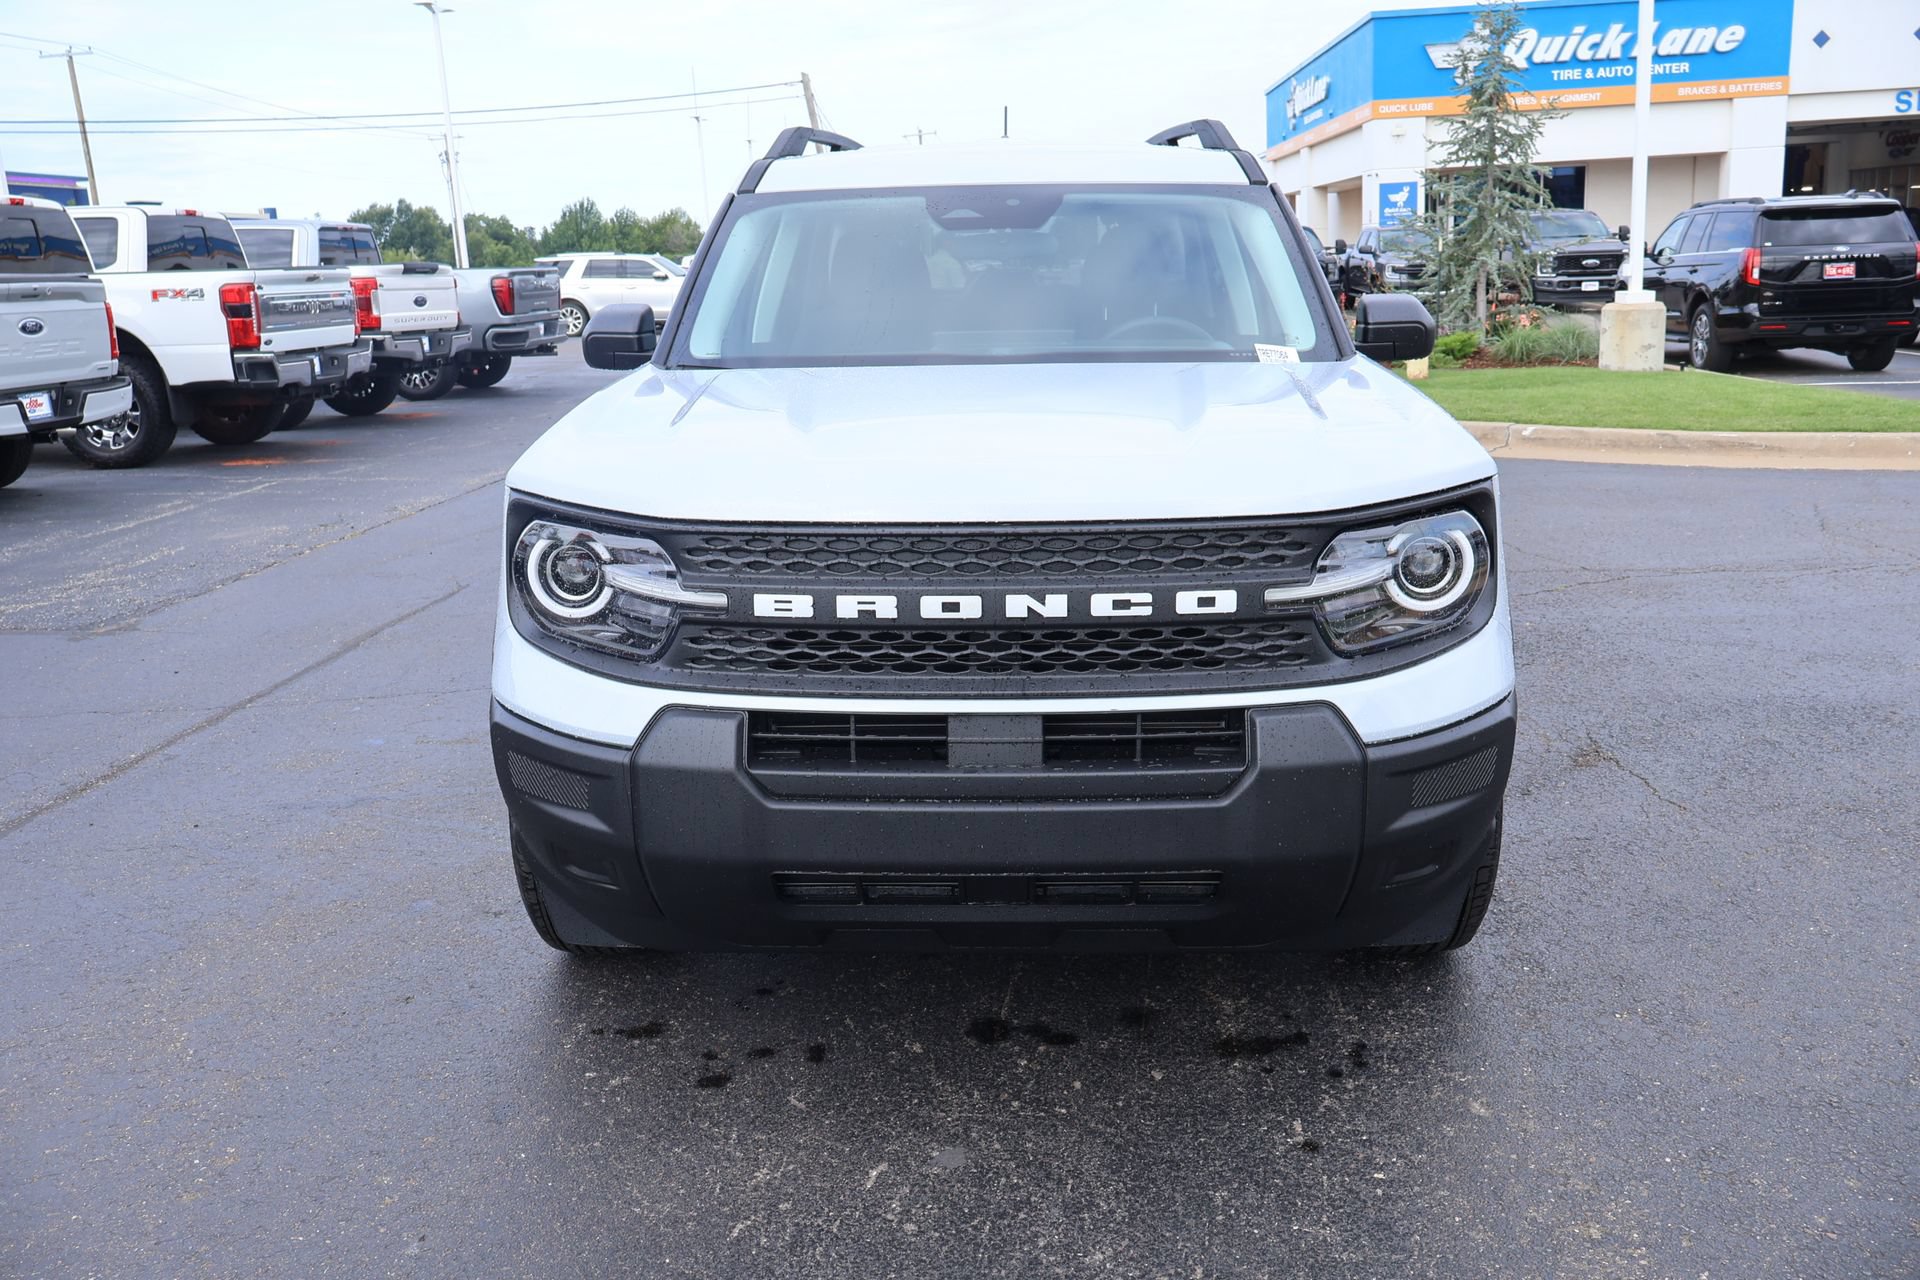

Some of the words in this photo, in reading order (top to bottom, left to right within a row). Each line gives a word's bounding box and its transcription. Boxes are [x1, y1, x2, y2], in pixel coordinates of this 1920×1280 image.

[1503, 23, 1632, 69] Quick
[1552, 69, 1582, 80] TIRE
[1585, 68, 1594, 79] &
[1597, 65, 1633, 78] AUTO
[1649, 62, 1690, 75] ENTER
[1678, 85, 1718, 96] BRAKES
[1719, 85, 1727, 94] &
[1729, 81, 1783, 93] BATTERIES
[1549, 92, 1602, 103] AGNMENT
[1379, 104, 1408, 114] QUICK
[1409, 102, 1434, 112] LUBE
[152, 288, 205, 301] FX4
[753, 589, 1238, 619] BRONCO
